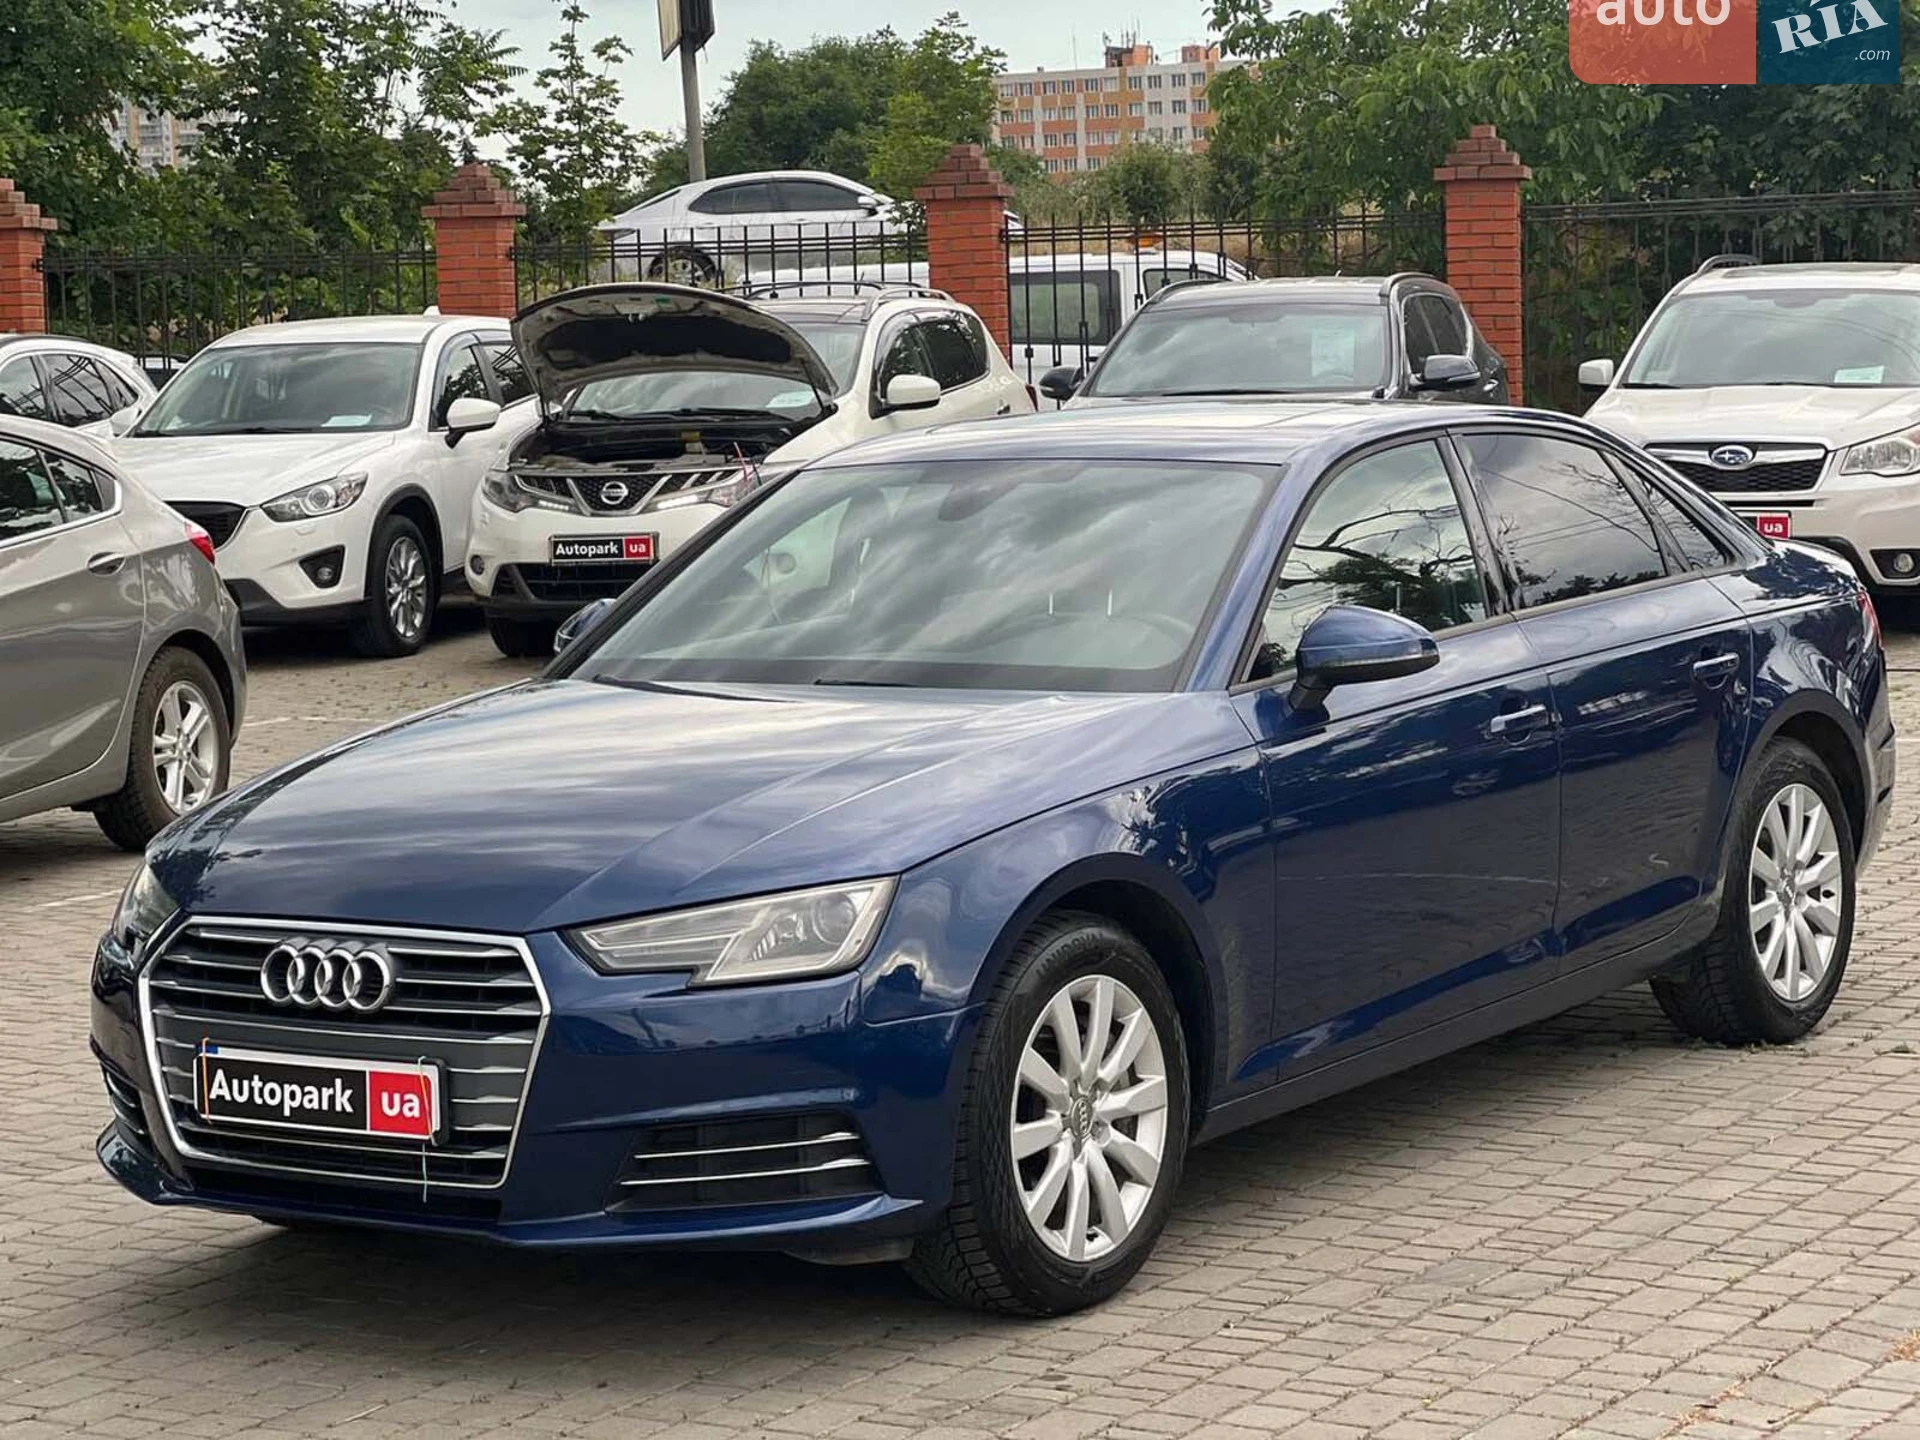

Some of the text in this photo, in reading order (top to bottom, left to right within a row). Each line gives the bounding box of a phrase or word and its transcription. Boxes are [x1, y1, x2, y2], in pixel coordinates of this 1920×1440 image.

[1764, 523, 1783, 533] ua
[556, 541, 646, 557] Autopark ua
[209, 1068, 421, 1118] Autopark ua
